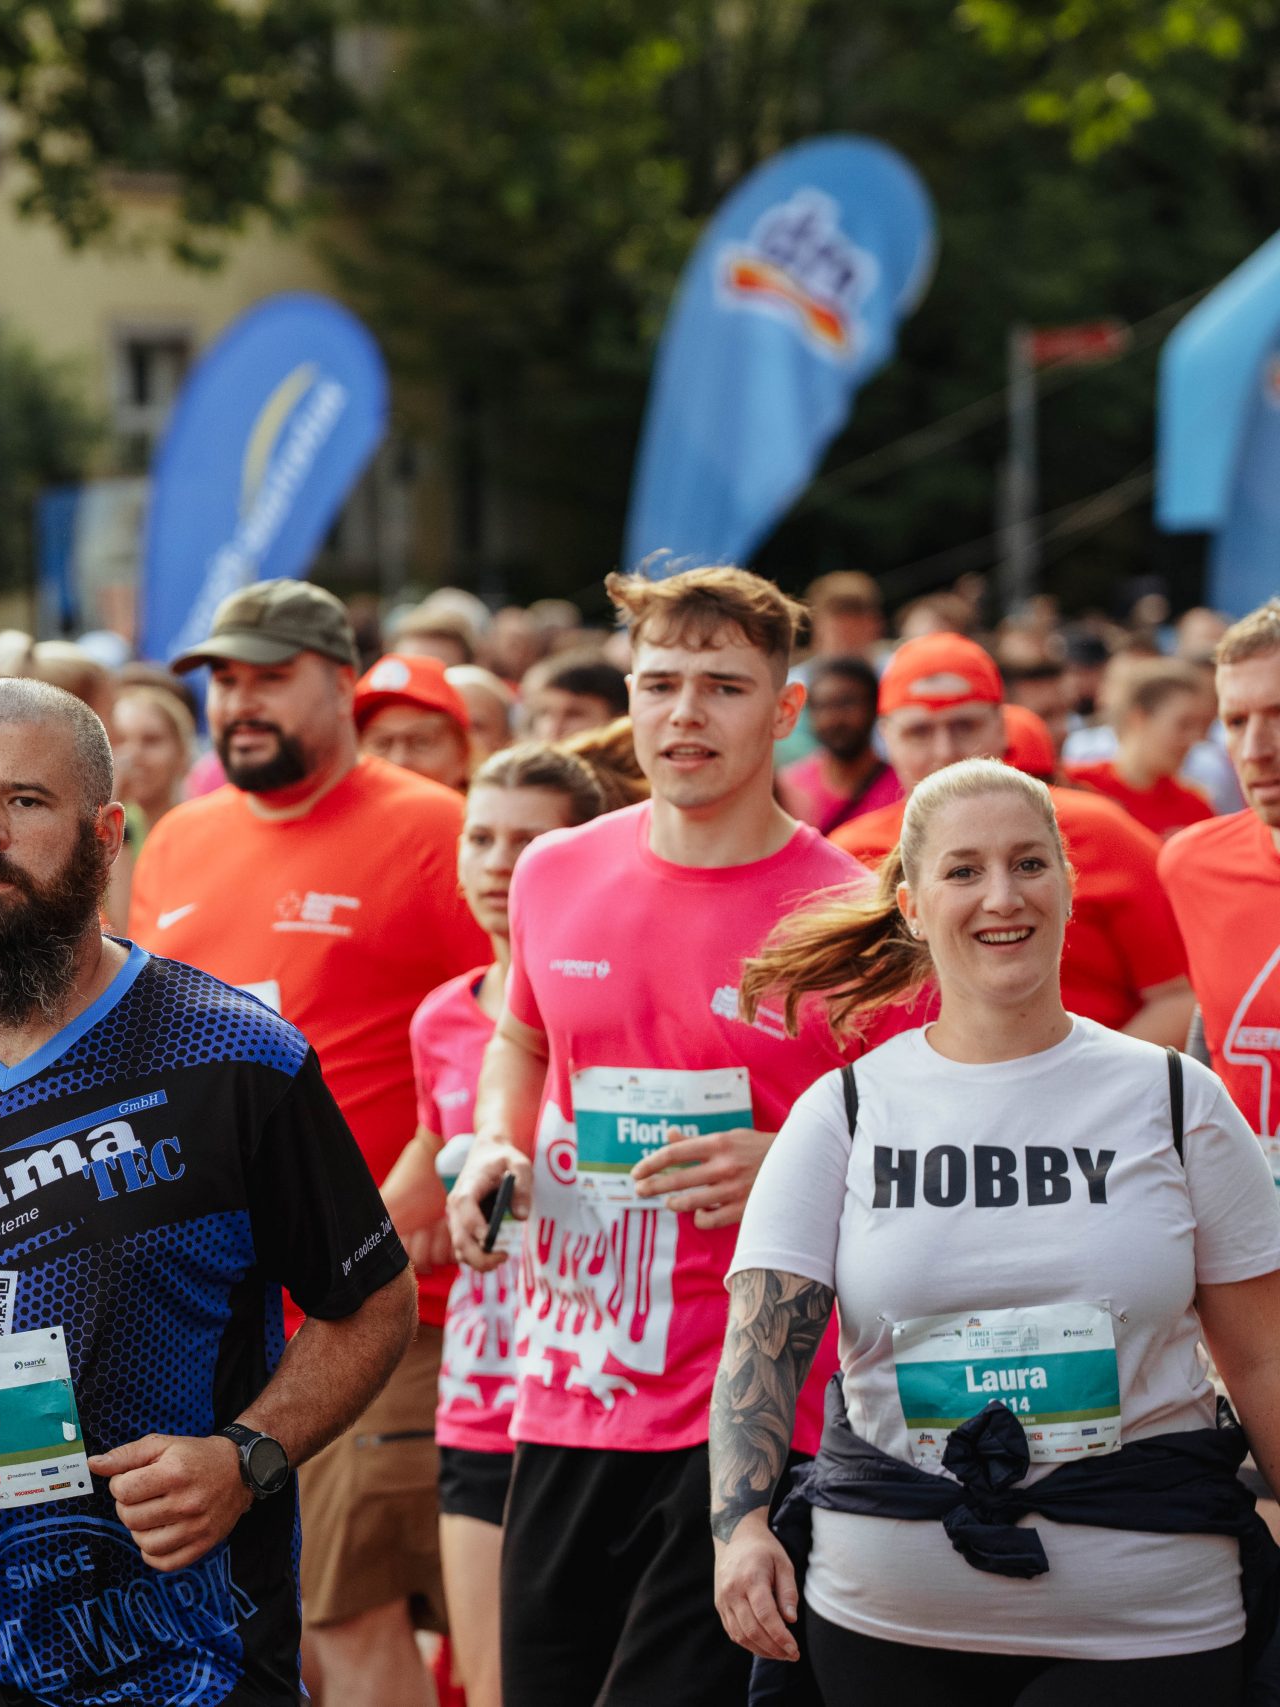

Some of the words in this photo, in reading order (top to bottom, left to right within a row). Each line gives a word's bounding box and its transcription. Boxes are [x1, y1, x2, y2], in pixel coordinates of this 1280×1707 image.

[118, 1094, 159, 1115] GmbH
[617, 1116, 700, 1144] Florin
[82, 1136, 186, 1202] TEC
[872, 1144, 1117, 1209] HOBBY
[354, 1232, 382, 1262] coolste
[965, 1366, 1048, 1393] Laura
[5, 1545, 96, 1590] SINCE
[57, 1544, 260, 1677] WORK
